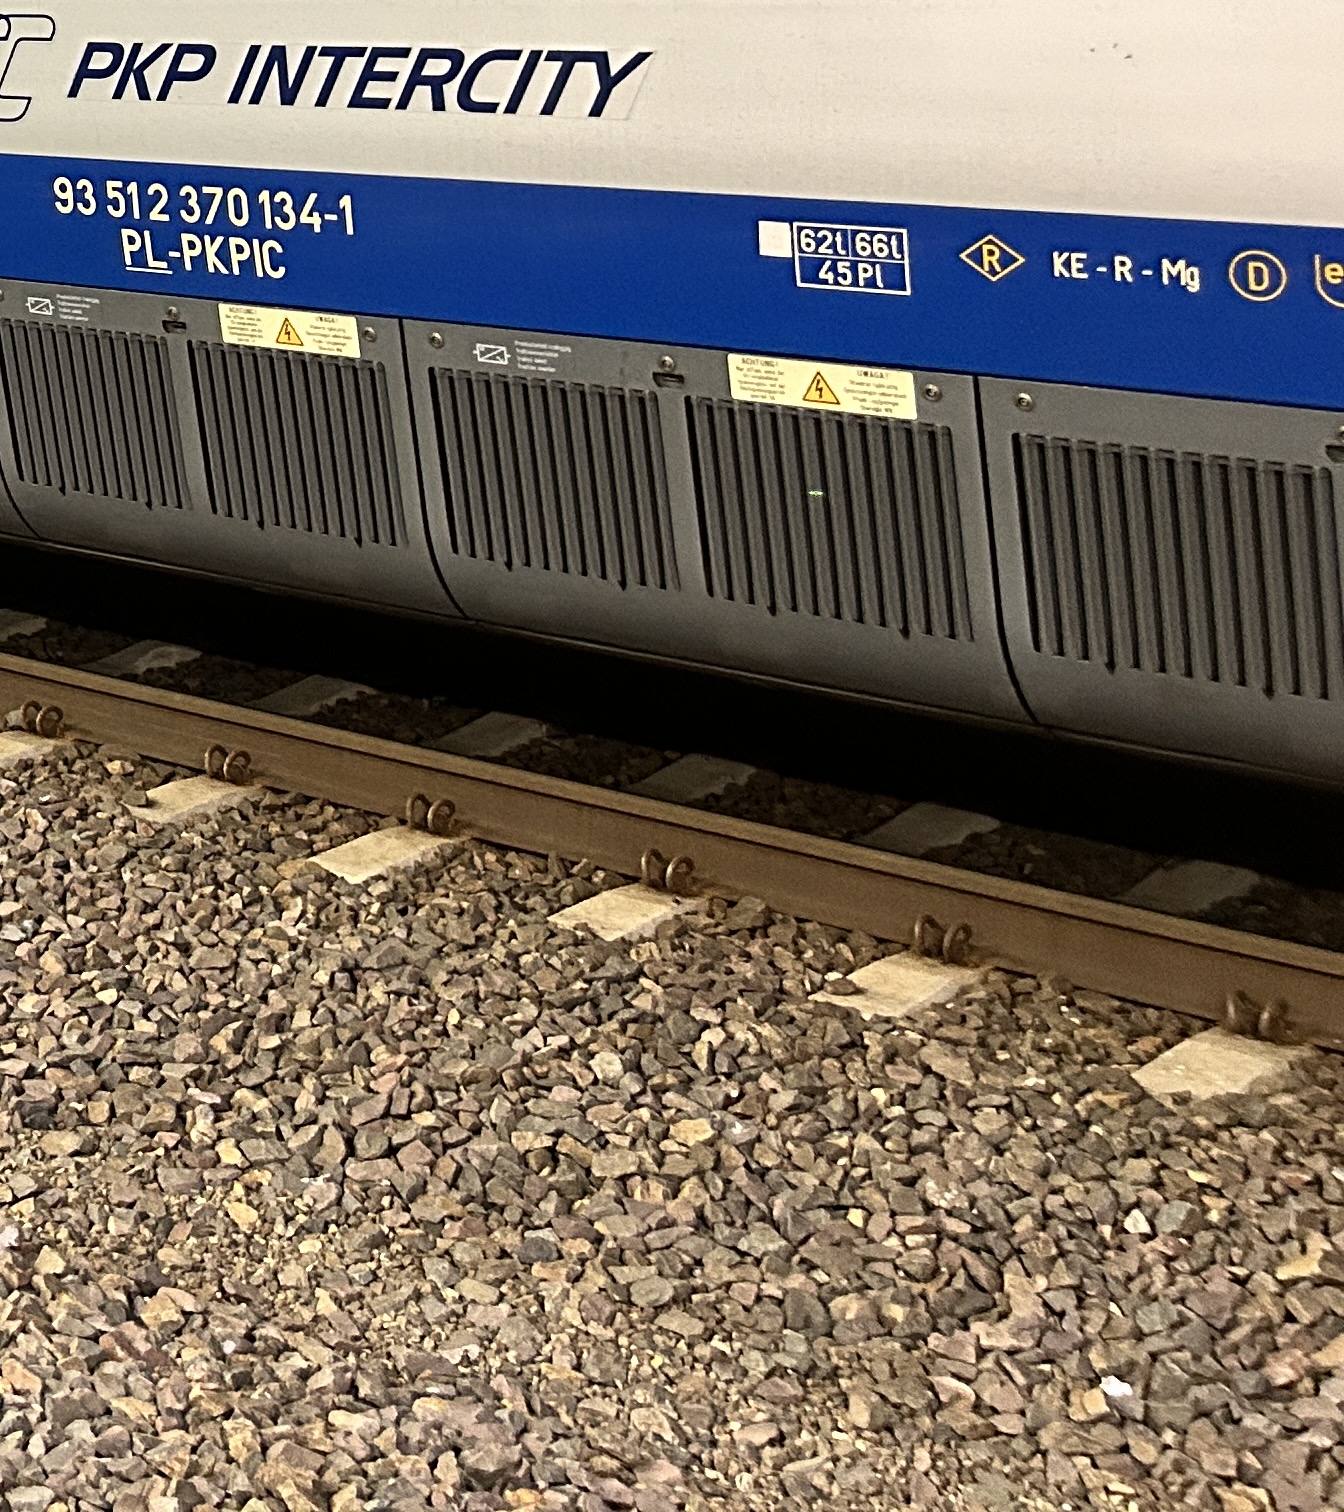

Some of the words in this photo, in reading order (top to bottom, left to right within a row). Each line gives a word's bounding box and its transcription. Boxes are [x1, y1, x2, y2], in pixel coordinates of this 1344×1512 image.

[67, 42, 217, 101] PKP
[227, 45, 654, 118] INTERCITY
[53, 176, 97, 216] 93
[178, 184, 250, 227] 370
[258, 189, 354, 235] 134-1
[120, 228, 286, 279] PL-PKPIC
[800, 228, 847, 256] 62t
[855, 232, 902, 259] 66t
[981, 244, 1002, 273] R
[818, 260, 853, 286] 45
[1247, 261, 1269, 292] D
